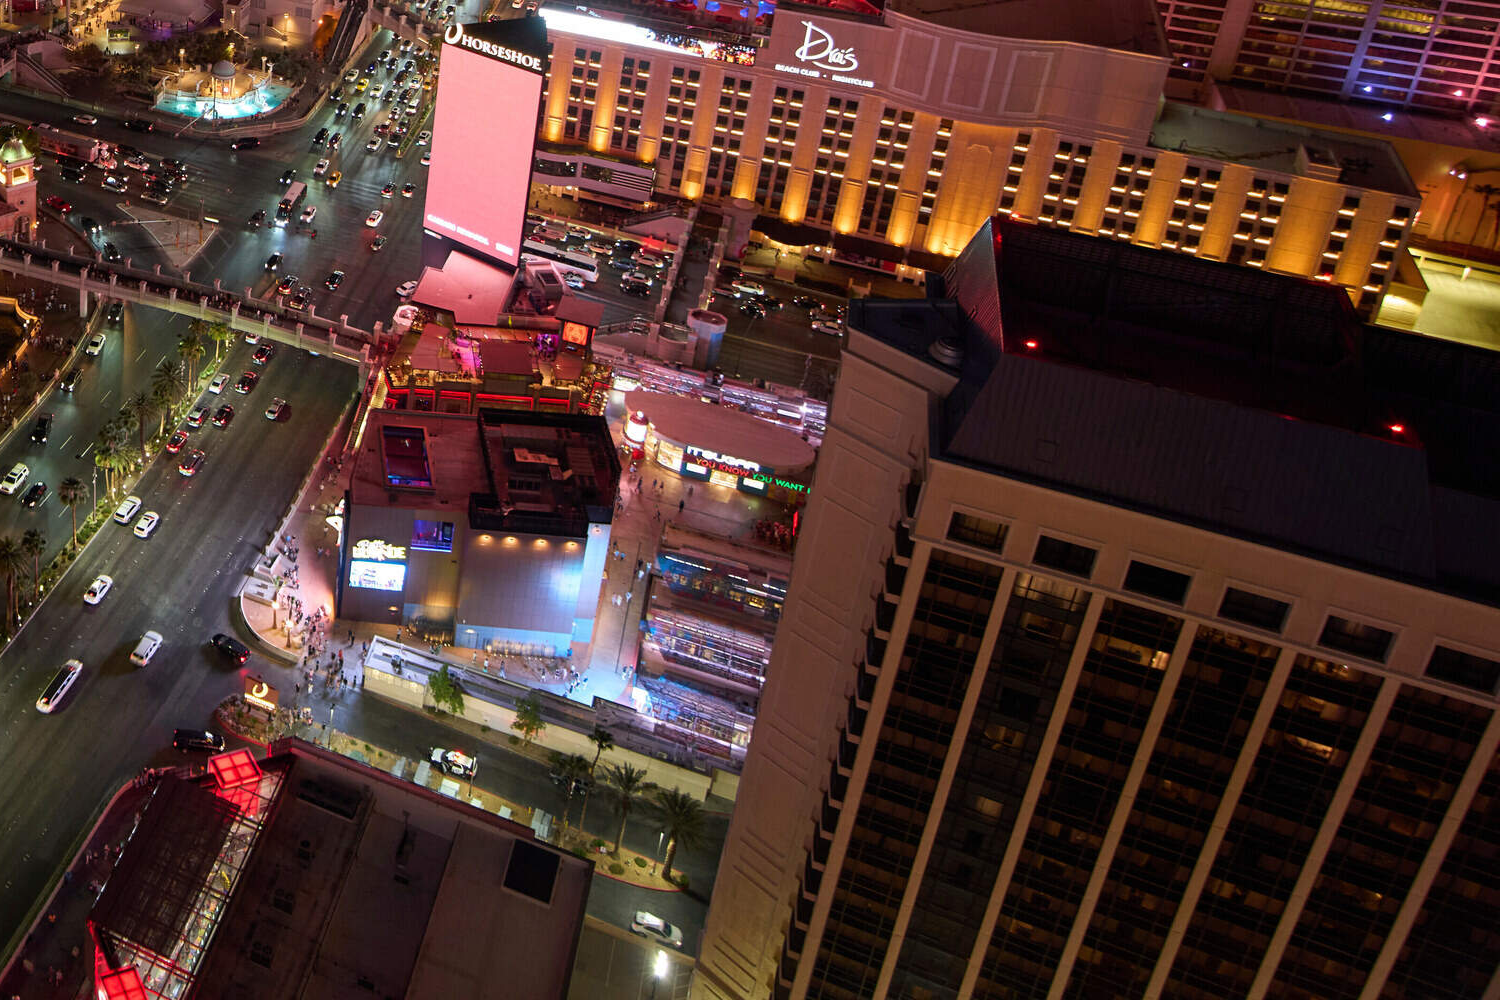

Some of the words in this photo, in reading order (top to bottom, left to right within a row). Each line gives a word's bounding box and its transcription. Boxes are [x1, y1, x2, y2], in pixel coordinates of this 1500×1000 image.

[461, 34, 542, 71] HORSESHOE
[775, 64, 799, 74] BEACH
[800, 69, 820, 78] CLUB
[832, 75, 874, 88] NIGHTCLUB
[696, 458, 716, 469] YOU
[719, 464, 750, 477] KNOW
[752, 473, 773, 484] YOU
[775, 478, 805, 492] WANT
